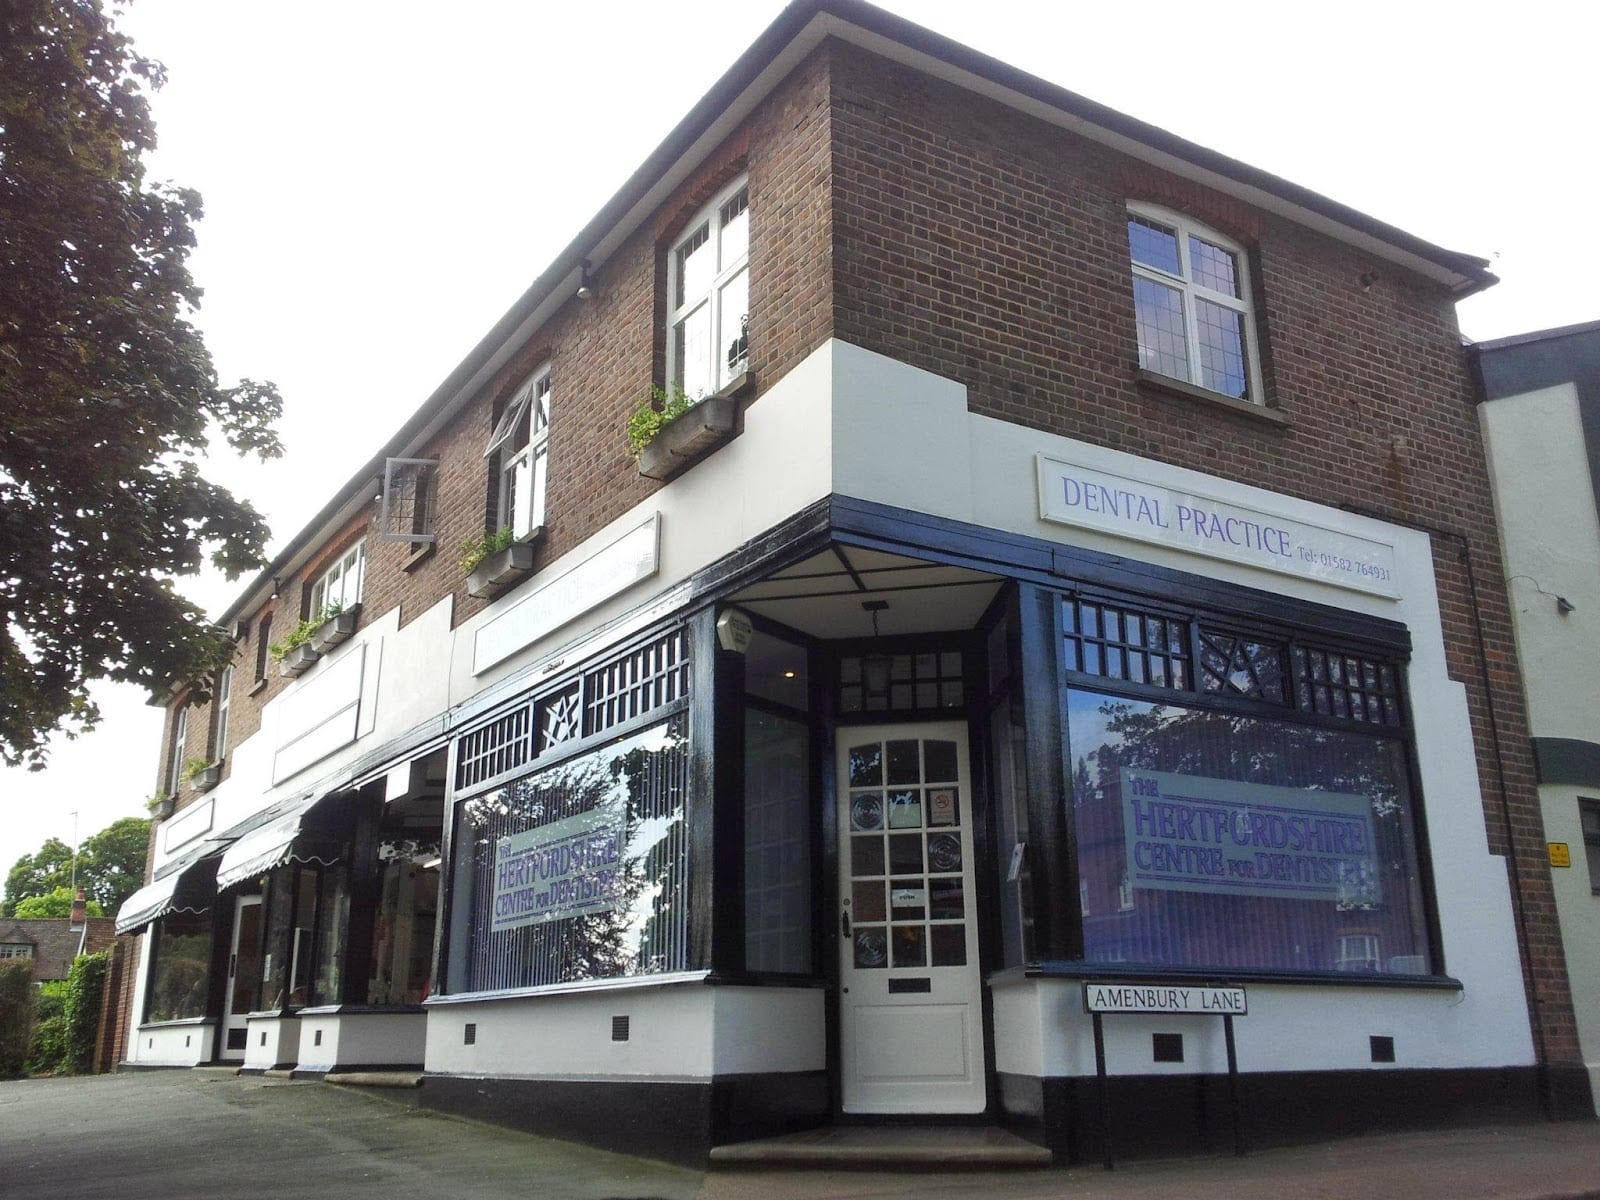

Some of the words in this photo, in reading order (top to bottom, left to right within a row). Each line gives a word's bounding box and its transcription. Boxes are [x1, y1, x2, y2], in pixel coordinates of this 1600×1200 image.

[1061, 476, 1169, 528] DENTAL
[1175, 504, 1292, 558] PRACTICE
[1297, 546, 1318, 564] Tel:
[1320, 553, 1352, 572] 01582
[1355, 561, 1391, 581] 764931
[1129, 777, 1159, 797] THE
[1131, 799, 1366, 856] HERTFORDSHIRE
[498, 834, 618, 891] HERTFORDSHIRE
[1134, 840, 1225, 876] CENTRE
[1226, 859, 1257, 878] FOR
[495, 887, 535, 917] CENTRE
[1094, 988, 1191, 1009] AMENBURY
[1201, 991, 1242, 1010] LANE
